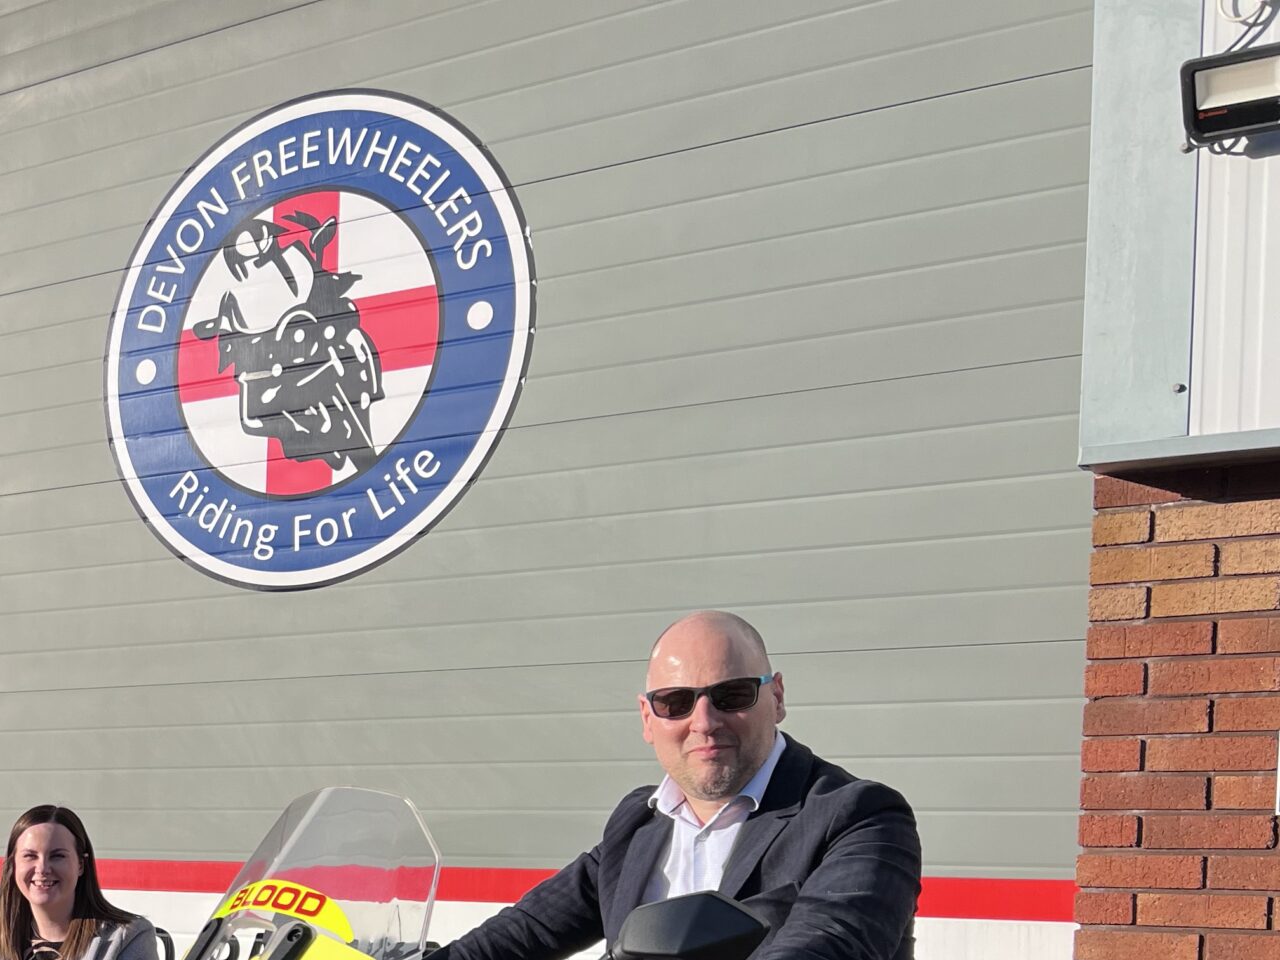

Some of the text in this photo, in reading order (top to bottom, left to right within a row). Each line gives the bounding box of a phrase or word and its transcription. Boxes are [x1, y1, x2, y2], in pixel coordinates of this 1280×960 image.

[137, 126, 493, 334] DEVON FREEWHEELERS
[169, 448, 442, 561] Riding For Life
[229, 885, 328, 918] BLOOD
